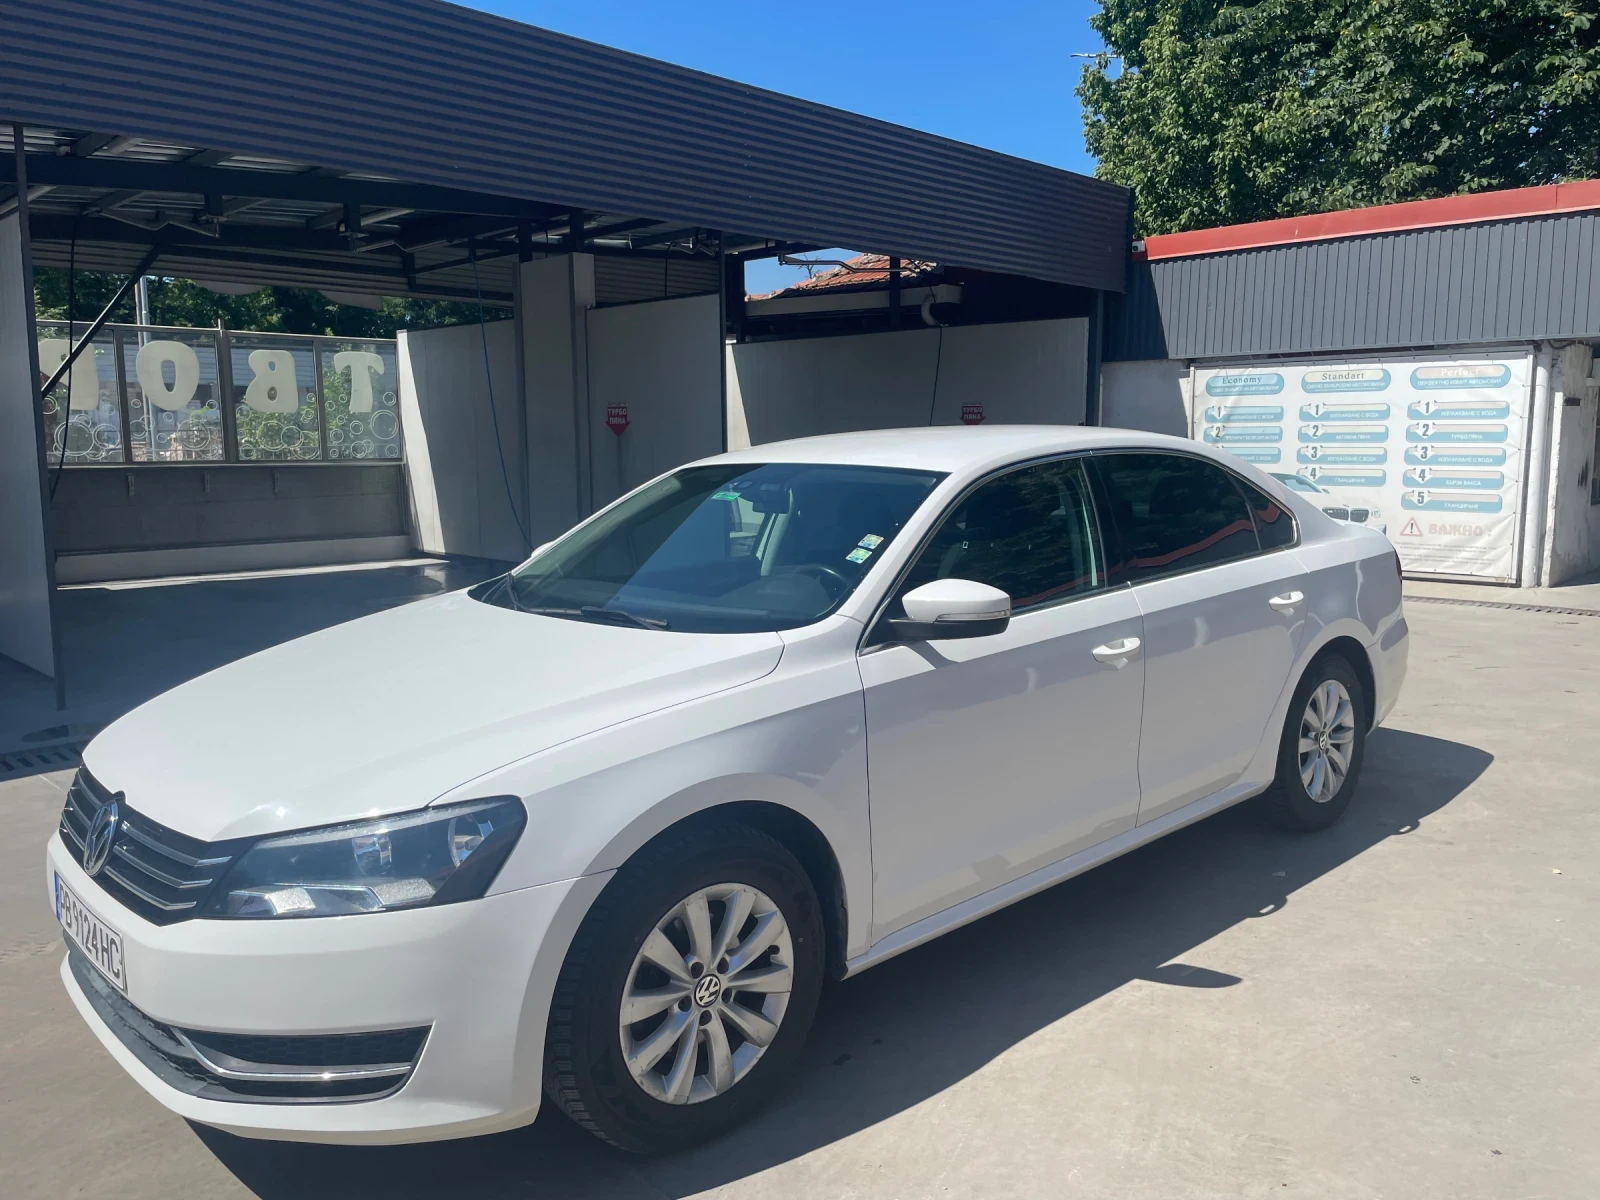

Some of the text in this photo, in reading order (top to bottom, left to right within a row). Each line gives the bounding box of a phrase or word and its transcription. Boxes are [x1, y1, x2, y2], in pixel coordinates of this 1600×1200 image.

[1222, 376, 1262, 385] Economy
[1322, 372, 1364, 381] Standart
[608, 408, 627, 416] ТУРБО
[1217, 406, 1221, 417] 1
[1314, 404, 1319, 416] 1
[1425, 401, 1430, 414] 1
[609, 417, 627, 425] ПЯНА
[1215, 427, 1221, 438] 2
[1312, 425, 1319, 437] 2
[1422, 424, 1429, 437] 2
[1311, 446, 1318, 458] 3
[1420, 446, 1428, 459] 3
[1310, 467, 1316, 479] 4
[1418, 469, 1426, 482] 4
[1417, 491, 1424, 504] 5
[1428, 523, 1484, 537] ВАЖНО
